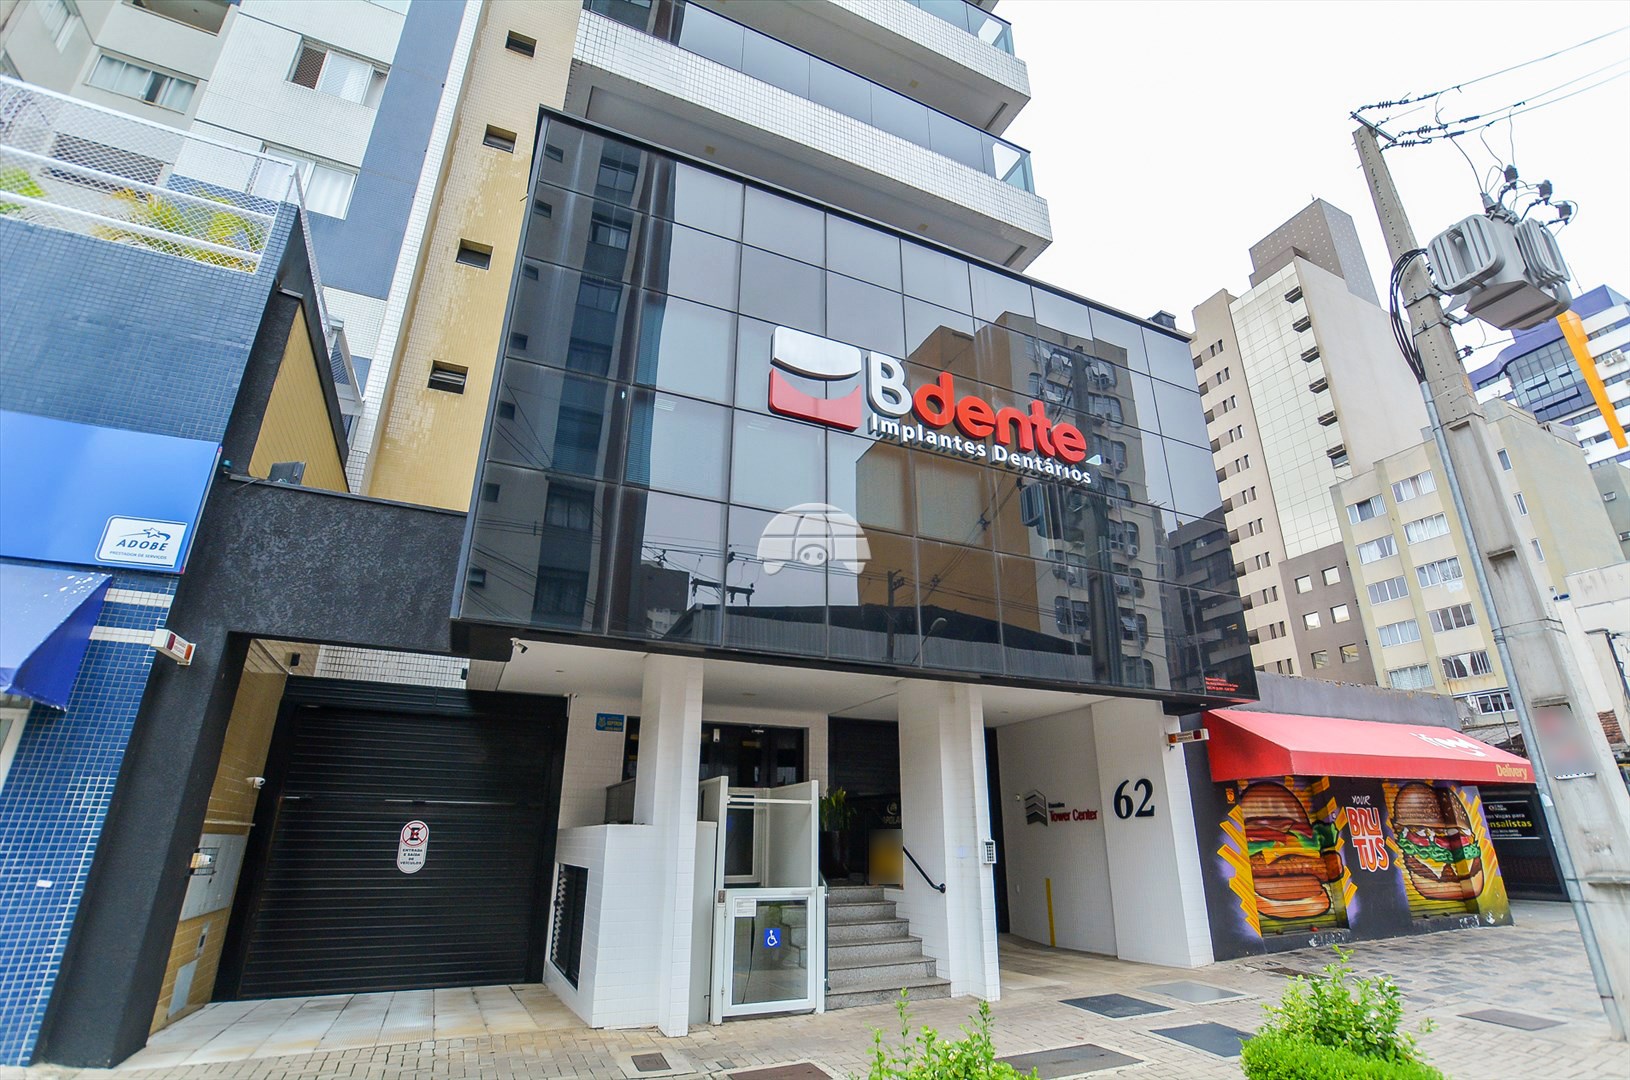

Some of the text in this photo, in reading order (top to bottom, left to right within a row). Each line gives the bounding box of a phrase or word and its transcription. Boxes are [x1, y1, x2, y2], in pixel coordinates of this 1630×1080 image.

[867, 350, 1088, 464] Bdente
[869, 413, 1093, 484] Implantes Dentários
[116, 538, 168, 551] ADOBE
[1496, 763, 1528, 780] Delivery
[1113, 778, 1155, 819] 62
[1351, 794, 1372, 806] YOUR
[1049, 808, 1098, 822] Tower Center
[1351, 836, 1390, 873] TUS
